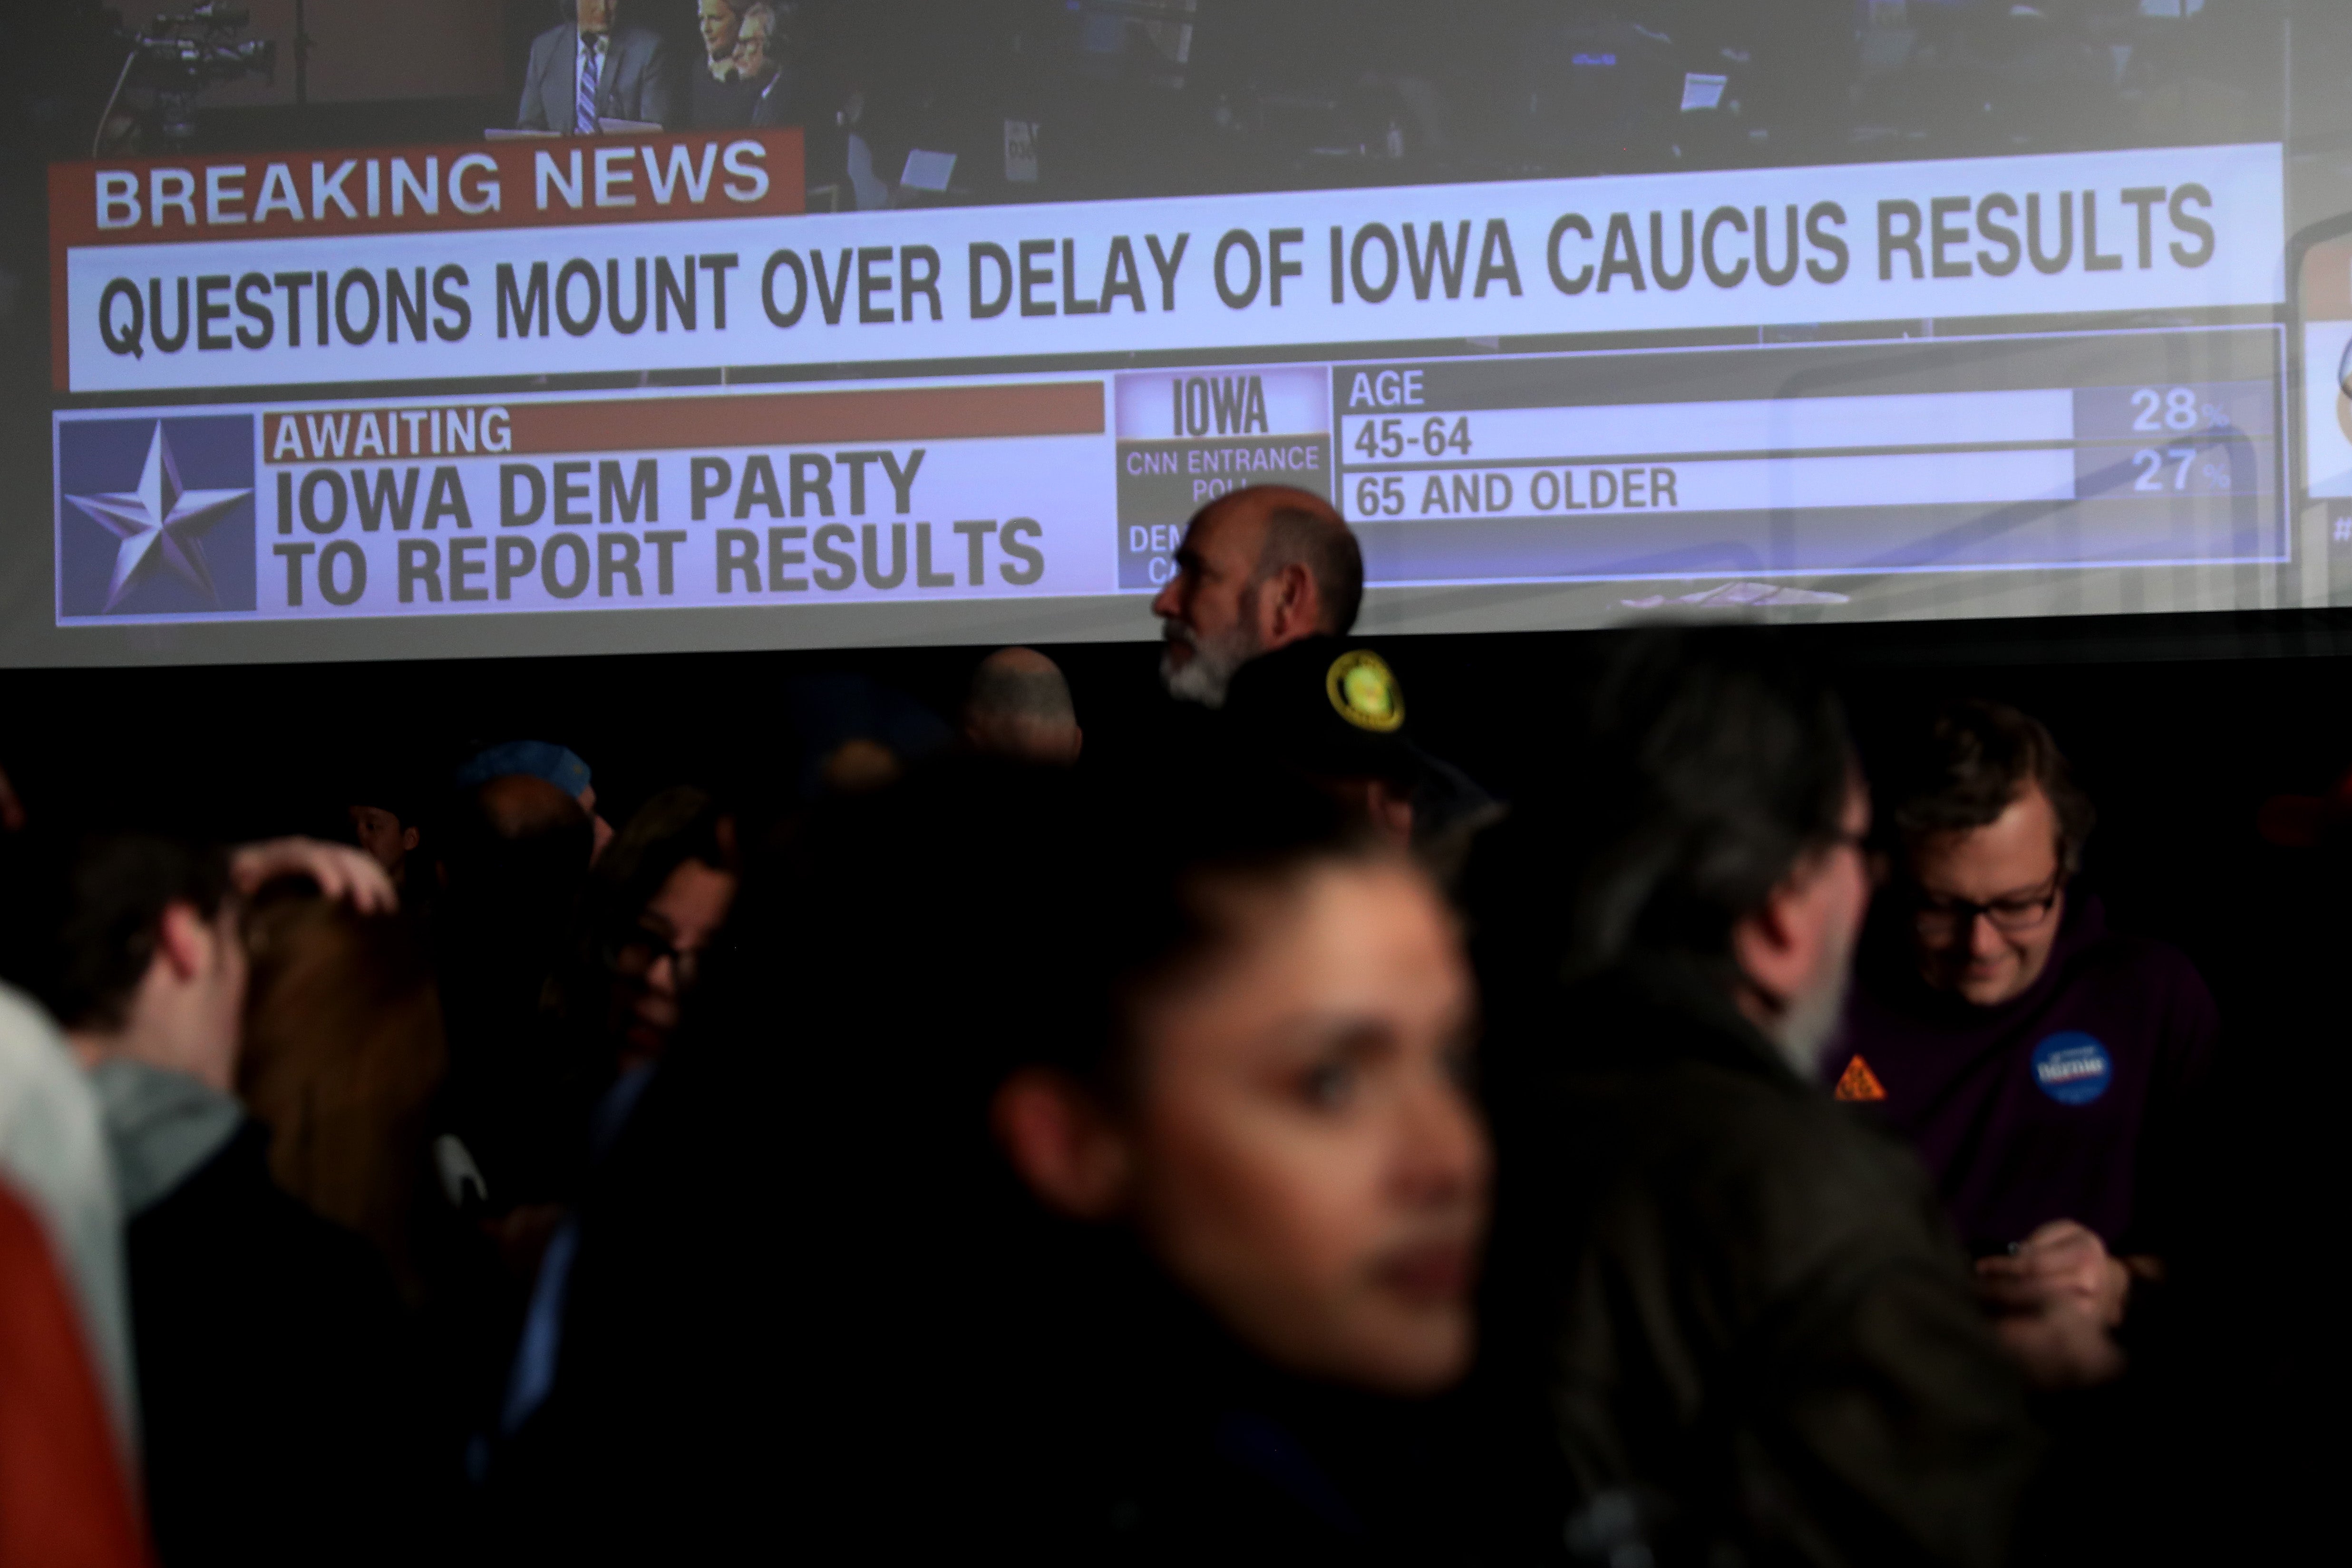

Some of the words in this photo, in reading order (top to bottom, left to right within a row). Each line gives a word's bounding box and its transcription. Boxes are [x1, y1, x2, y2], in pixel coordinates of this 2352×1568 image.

[96, 153, 501, 230] BREAKING
[535, 139, 769, 210] NEWS
[99, 263, 472, 360] QUESTIONS
[496, 253, 739, 339] MOUNT
[761, 244, 943, 328] OVER
[969, 232, 1190, 320] DELAY
[1214, 227, 1304, 310] OF
[1330, 217, 1524, 304] IOWA
[1546, 200, 1850, 295] CAUCUS
[1877, 182, 2216, 281] RESULTS
[1172, 375, 1268, 436] IOWA
[1349, 370, 1424, 408] AGE
[272, 407, 512, 459] AWAITING
[1126, 451, 1178, 475] CNN
[1188, 446, 1320, 474] ENTRANCE
[1354, 416, 1472, 458] 45-64
[276, 465, 472, 535] IOWA
[499, 458, 659, 527] DEM
[690, 449, 926, 521] PARTY
[1356, 476, 1405, 516] 65
[1421, 473, 1513, 514] AND
[1530, 467, 1678, 510] OLDER
[273, 539, 367, 607] TO
[397, 529, 687, 604] REPORT
[716, 516, 1045, 594] RESULTS
